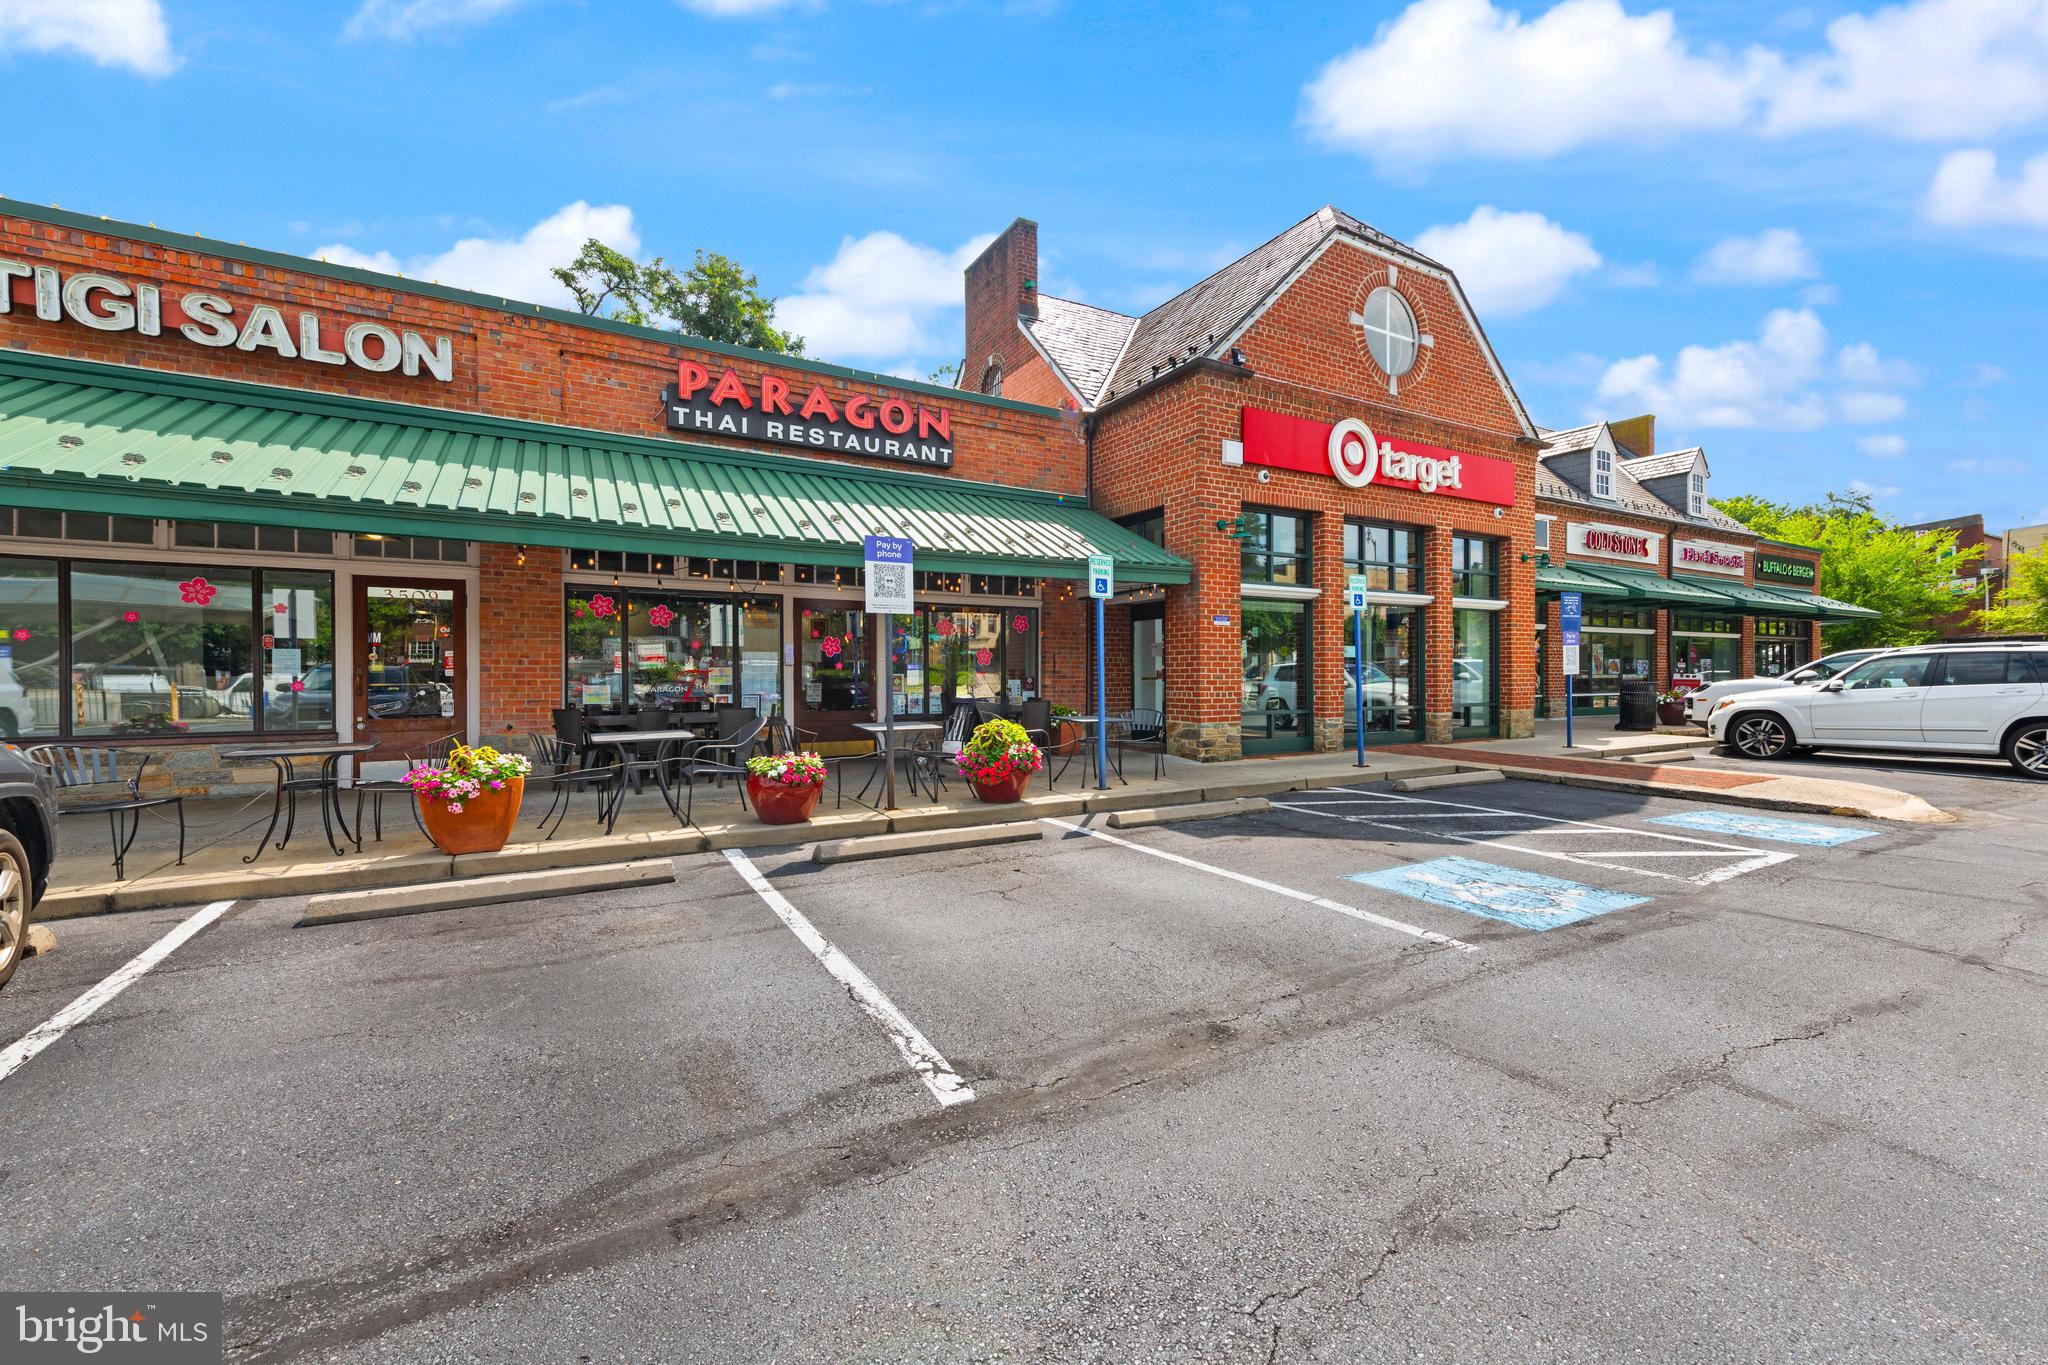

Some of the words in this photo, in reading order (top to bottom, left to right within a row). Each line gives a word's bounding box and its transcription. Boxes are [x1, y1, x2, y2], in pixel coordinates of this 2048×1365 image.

[0, 259, 161, 337] TIGI
[180, 292, 454, 382] SALON
[677, 358, 952, 443] PARAGON
[672, 406, 749, 434] THAI
[767, 421, 953, 464] RESTAURANT
[1379, 441, 1463, 494] target
[876, 540, 891, 551] Pay
[892, 542, 903, 551] by
[877, 551, 902, 559] phone
[1588, 530, 1613, 551] COLD
[1613, 534, 1642, 555] STONE
[1763, 560, 1788, 576] BUFFALO
[1793, 565, 1813, 579] BERGEN
[384, 588, 439, 604] 3509
